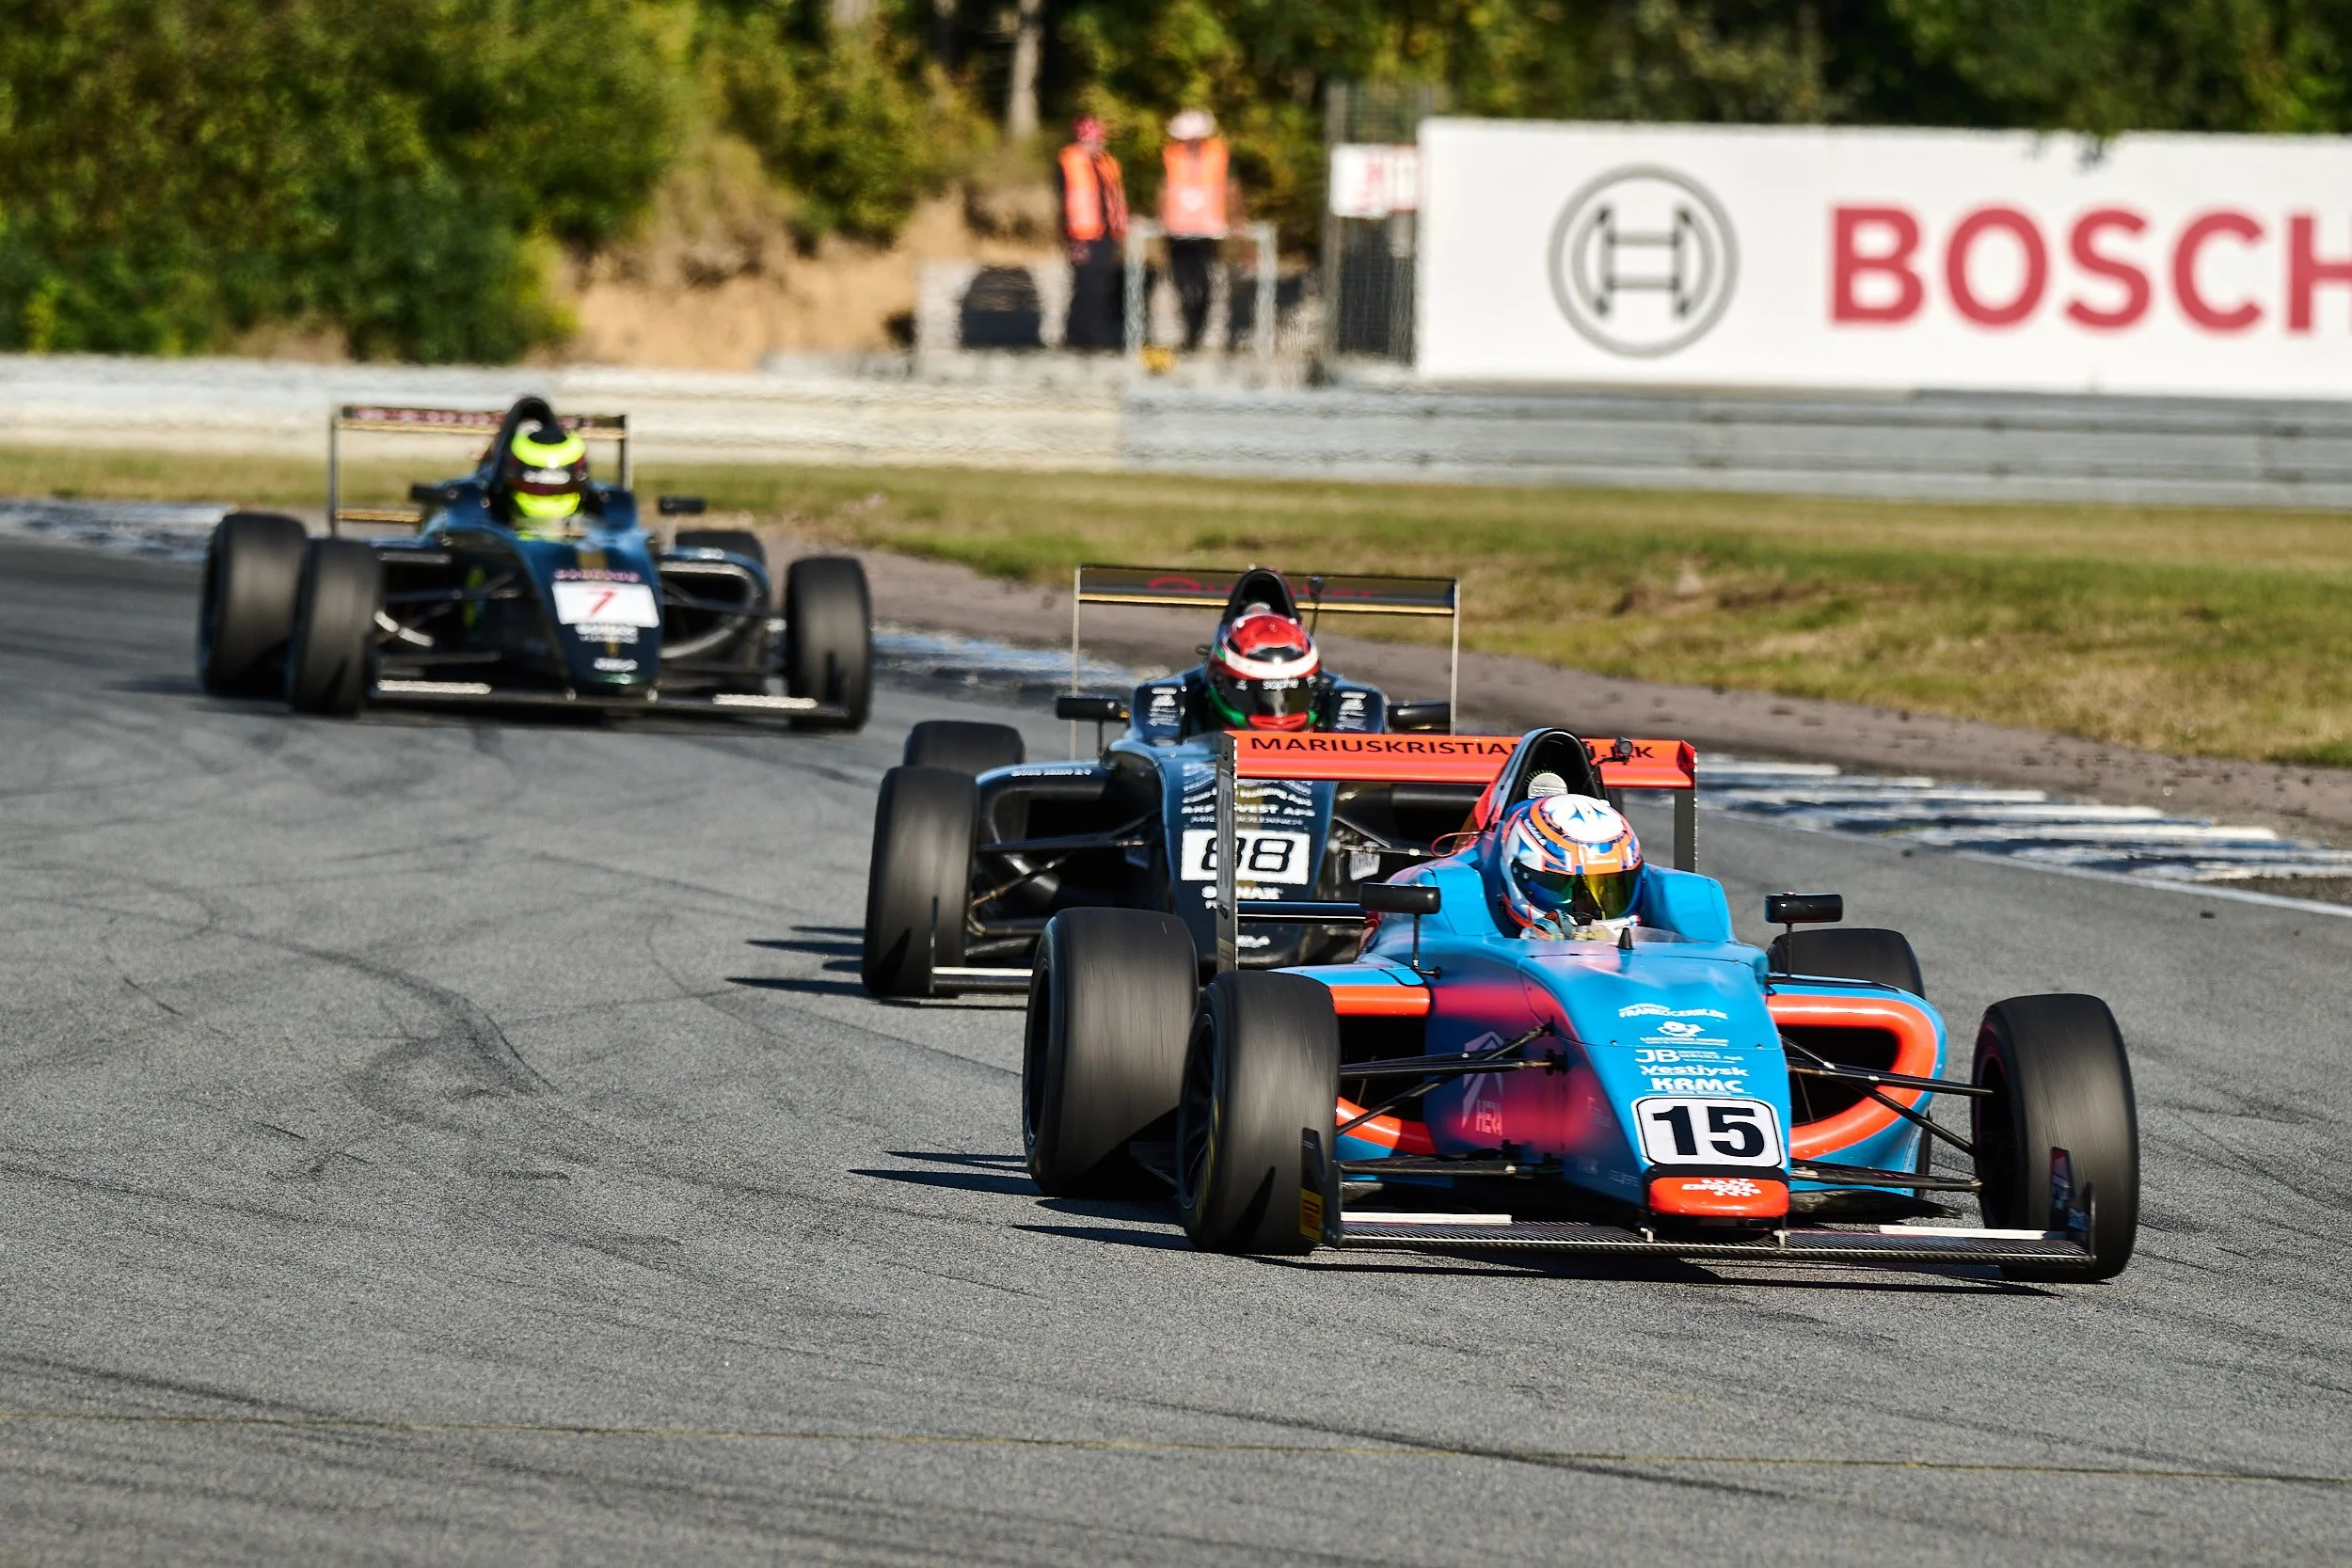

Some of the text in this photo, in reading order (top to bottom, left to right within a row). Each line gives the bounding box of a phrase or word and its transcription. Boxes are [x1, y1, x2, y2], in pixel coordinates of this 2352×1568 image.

[1830, 204, 2352, 333] BOSCH
[587, 586, 617, 618] 7
[1251, 737, 1655, 758] MARIUSKRISTIA.K
[1200, 837, 1295, 873] 88
[1634, 1049, 1681, 1063] JB
[1475, 1099, 1502, 1136] HERA
[1650, 1105, 1766, 1158] 15
